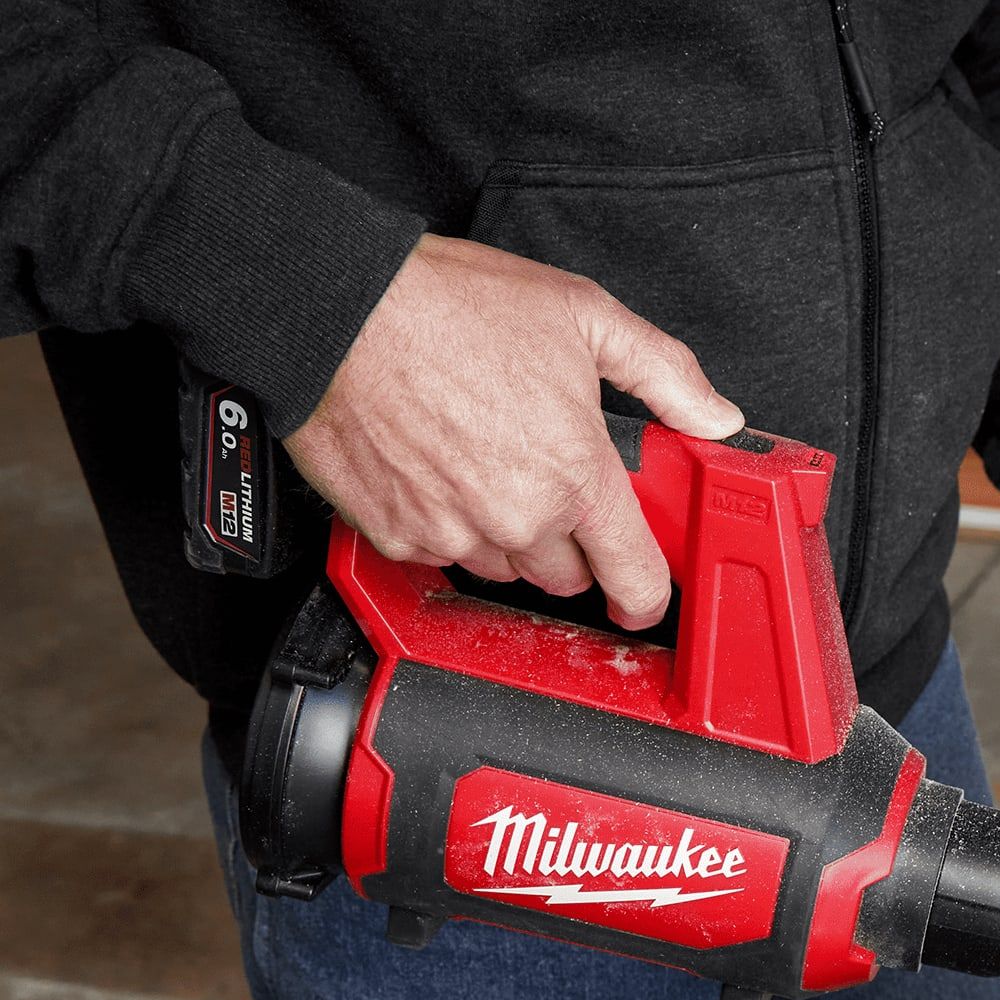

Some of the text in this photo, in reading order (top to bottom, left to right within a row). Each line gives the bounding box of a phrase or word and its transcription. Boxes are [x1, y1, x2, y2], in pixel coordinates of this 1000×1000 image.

[219, 400, 248, 460] 6.0 Ah
[221, 492, 237, 536] M12
[240, 434, 253, 543] REDLITHIUM
[470, 805, 747, 878] Milwaukee
